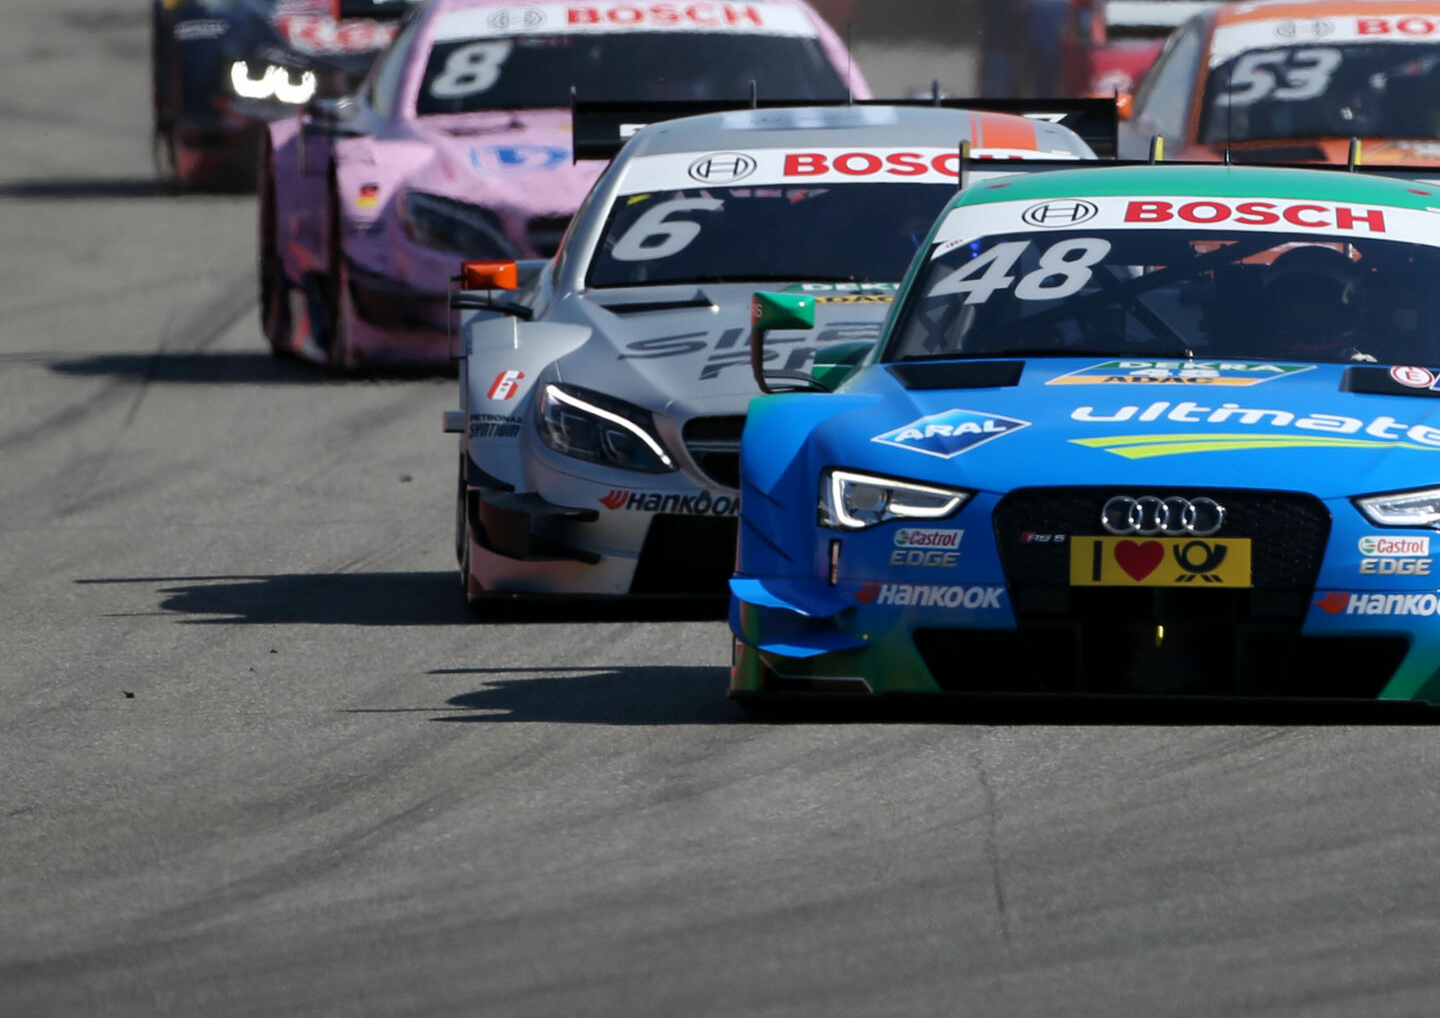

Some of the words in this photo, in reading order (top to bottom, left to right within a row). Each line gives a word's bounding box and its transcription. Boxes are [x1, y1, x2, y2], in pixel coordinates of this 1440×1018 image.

[566, 1, 763, 28] BOSCH
[429, 40, 513, 99] 8
[1215, 47, 1343, 106] 53
[782, 151, 1022, 178] BOSC
[1123, 199, 1387, 233] BOSCH
[611, 197, 725, 263] 6
[926, 236, 1113, 305] 48
[802, 282, 900, 292] DEK
[1118, 361, 1285, 372] DEKRA
[487, 369, 525, 400] 6
[893, 417, 1008, 443] ARAL
[907, 530, 959, 547] Castrol
[1377, 537, 1429, 555] Castrol
[888, 549, 961, 569] EDGE
[1092, 539, 1103, 581] I
[1358, 558, 1433, 577] EDGE
